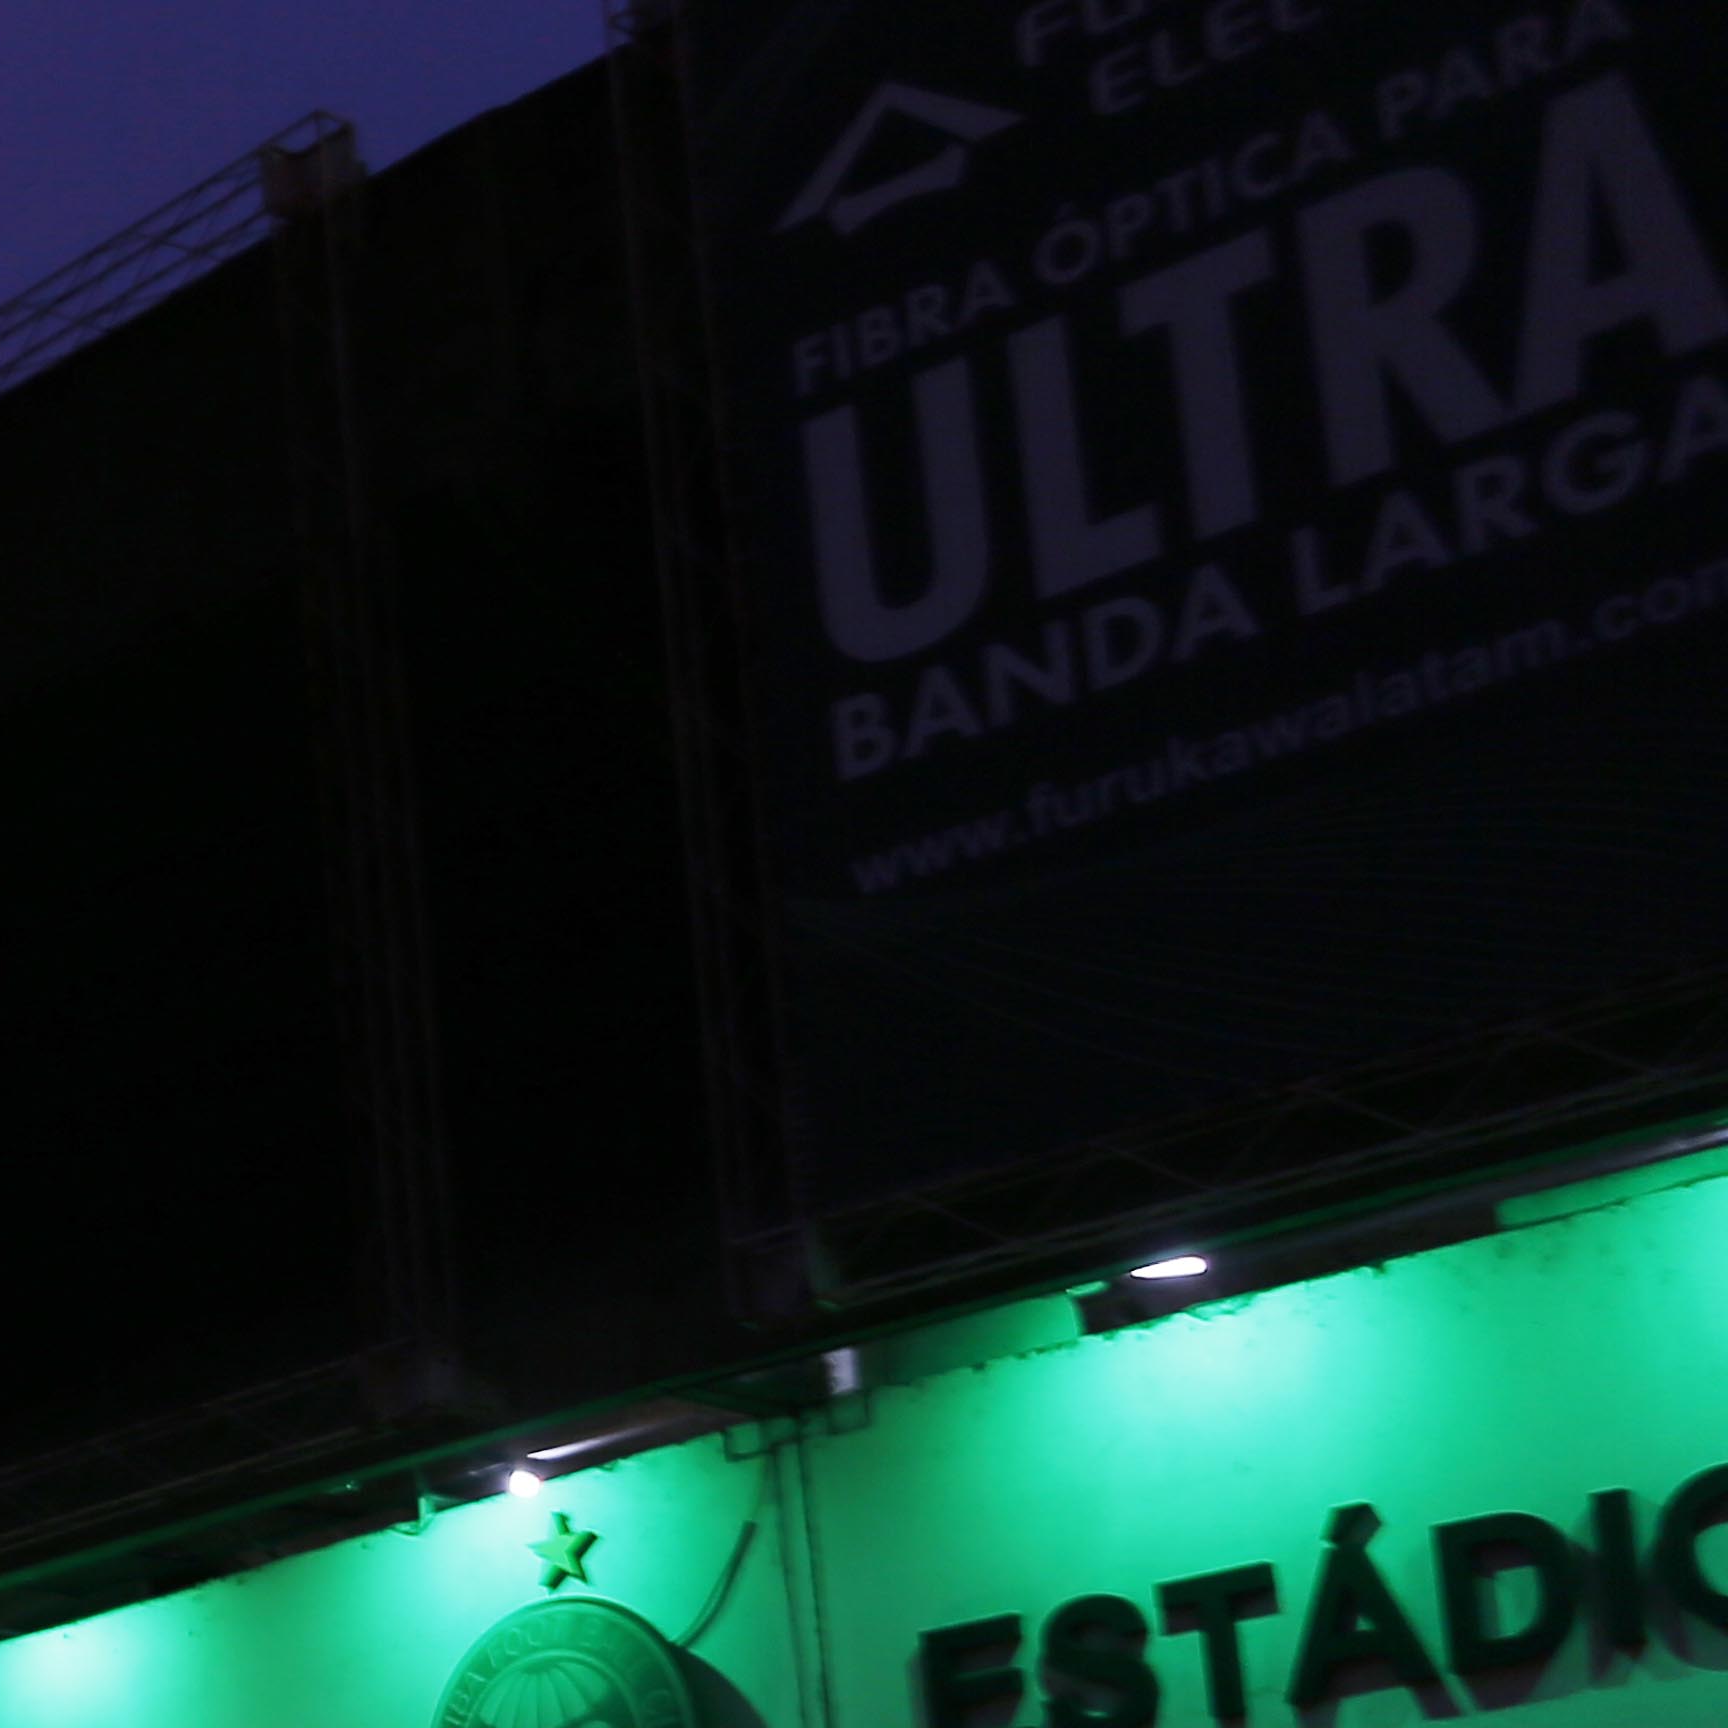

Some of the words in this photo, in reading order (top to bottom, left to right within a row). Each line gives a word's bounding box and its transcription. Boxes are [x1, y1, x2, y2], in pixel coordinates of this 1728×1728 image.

[791, 256, 1016, 398] FIBRA
[1030, 105, 1356, 285] ÓPTICA
[1375, 0, 1634, 140] PARA
[799, 68, 1728, 664] ULTRA
[828, 560, 1260, 783] BANDA
[1288, 374, 1728, 618] LARGA
